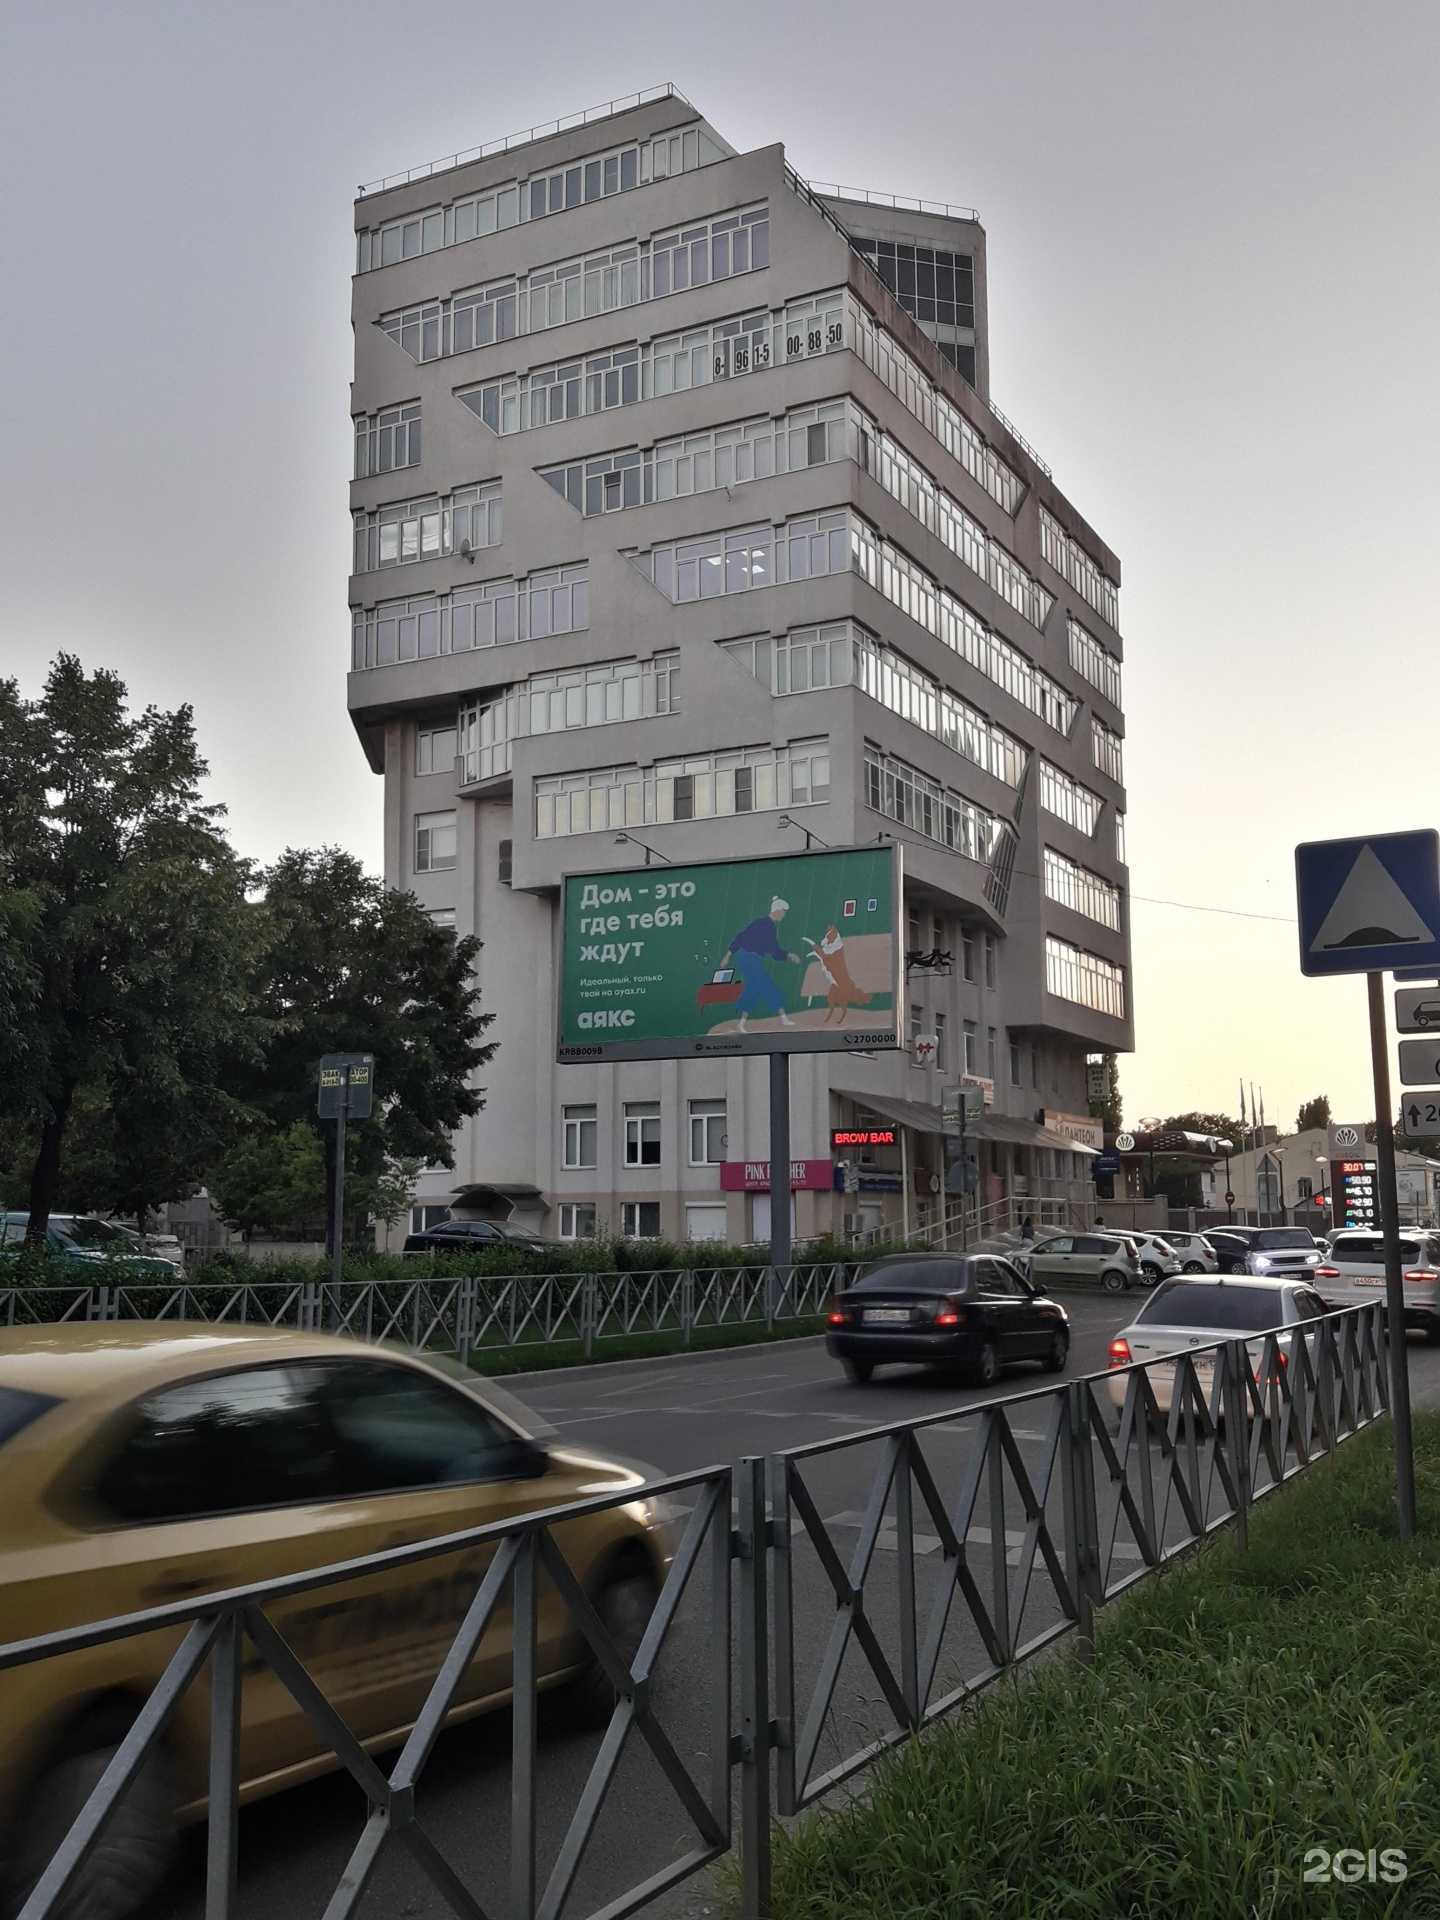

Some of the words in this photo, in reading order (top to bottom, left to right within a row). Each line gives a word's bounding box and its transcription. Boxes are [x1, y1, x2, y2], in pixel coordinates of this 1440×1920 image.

[580, 884, 632, 909] Дом
[655, 881, 696, 900] это
[580, 916, 621, 936] где
[627, 904, 683, 929] тебя
[580, 941, 644, 965] ждут
[633, 974, 663, 983] только
[577, 1009, 636, 1029] аякс
[853, 1034, 897, 1044] 2700000
[835, 1132, 869, 1144] BROW
[870, 1131, 895, 1143] BAR
[745, 1163, 765, 1180] PINK
